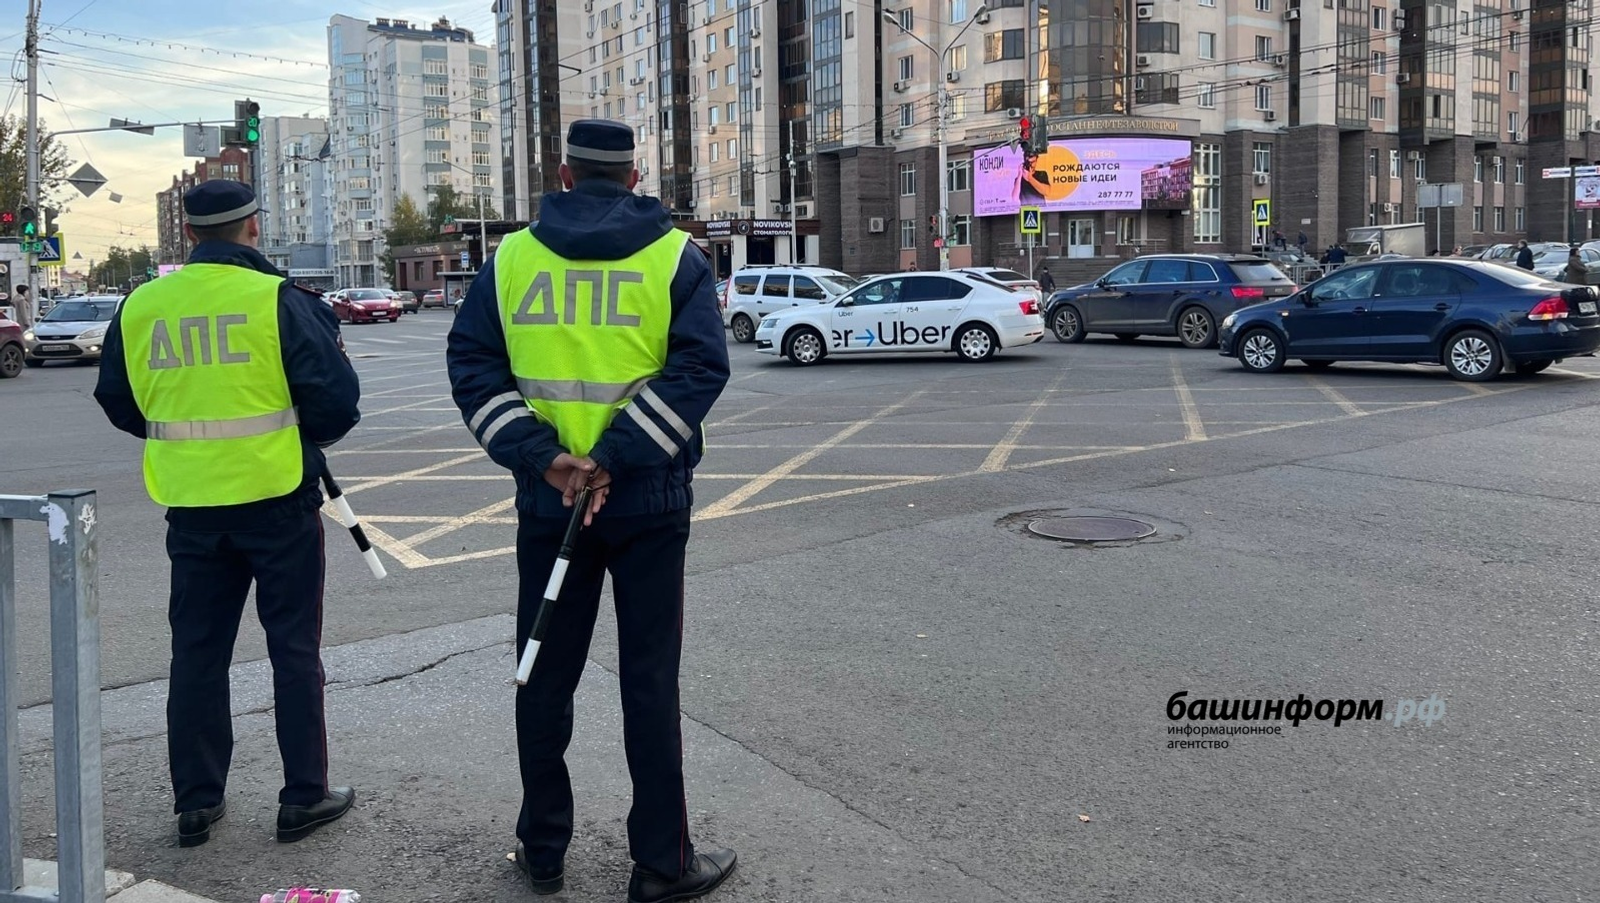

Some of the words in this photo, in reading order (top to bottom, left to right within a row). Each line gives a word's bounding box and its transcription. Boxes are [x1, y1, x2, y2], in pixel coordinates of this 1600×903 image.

[1053, 163, 1120, 172] РОЖДАЮТСЯ
[1053, 175, 1088, 183] НОВЫЕ
[1091, 174, 1117, 183] ИДЕИ
[511, 269, 644, 327] ДПС
[838, 309, 853, 317] Uber
[878, 321, 951, 345] Uber
[147, 314, 251, 370] ДПС
